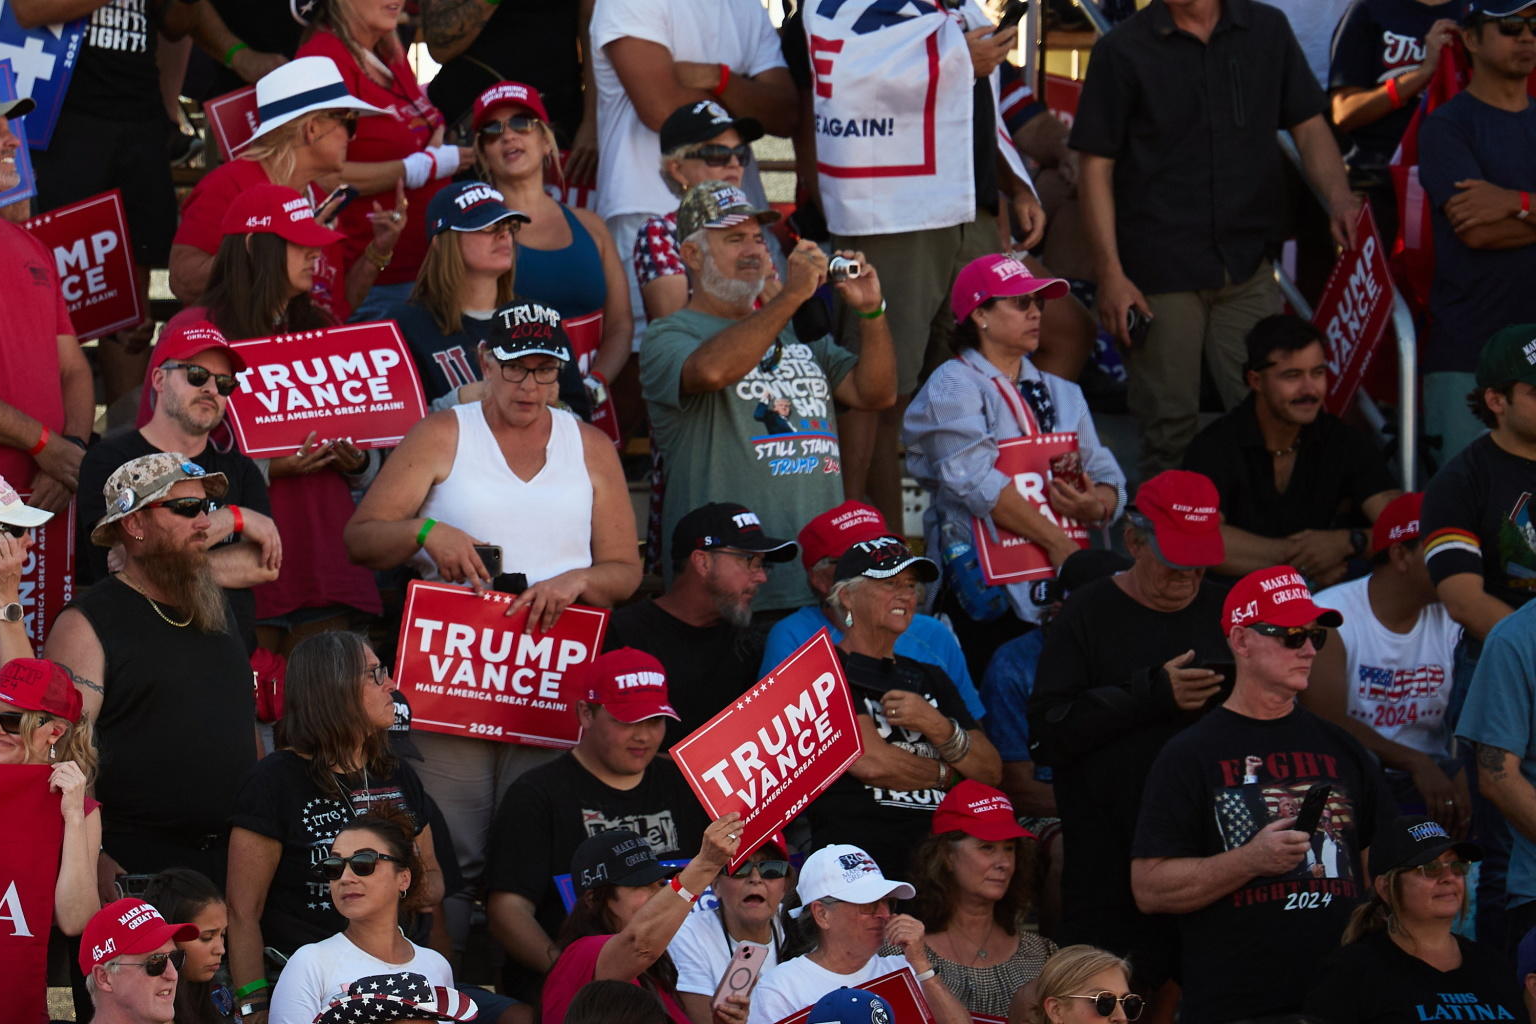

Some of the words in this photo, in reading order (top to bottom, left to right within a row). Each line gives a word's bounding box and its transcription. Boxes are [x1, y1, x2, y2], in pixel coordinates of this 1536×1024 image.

[822, 118, 894, 138] AGAIN!
[512, 323, 553, 341] 2024
[235, 347, 400, 395] TRUMP
[255, 376, 393, 414] VANCE
[255, 409, 284, 425] MAKE
[287, 403, 332, 420] AMERICA
[334, 404, 367, 417] GREAT
[369, 401, 406, 413] AGAIN!
[1260, 576, 1290, 593] MAKE
[1272, 588, 1300, 605] GREAT
[1230, 600, 1261, 625] 45-47
[414, 617, 588, 673] TRUMP
[429, 654, 564, 700] VANCE
[614, 670, 665, 690] TRUMP
[415, 682, 445, 695] MAKE
[446, 688, 493, 702] AMERICA
[495, 693, 530, 707] GREAT
[531, 699, 568, 713] AGAIN!
[1375, 703, 1418, 727] 2024
[468, 722, 505, 738] 2024
[700, 671, 837, 798] TRUMP
[735, 710, 834, 810] VANCE
[760, 778, 794, 811] AMERICA
[792, 754, 817, 781] GREAT
[816, 729, 843, 760] AGAIN!
[311, 809, 342, 828] 1776
[784, 793, 810, 822] 2024
[1284, 891, 1334, 911] 2024
[117, 905, 140, 926] MAKE
[127, 911, 156, 931] GREAT
[91, 937, 117, 963] 45-47
[1436, 992, 1479, 1005] THIS
[1415, 1004, 1516, 1022] LATINA
